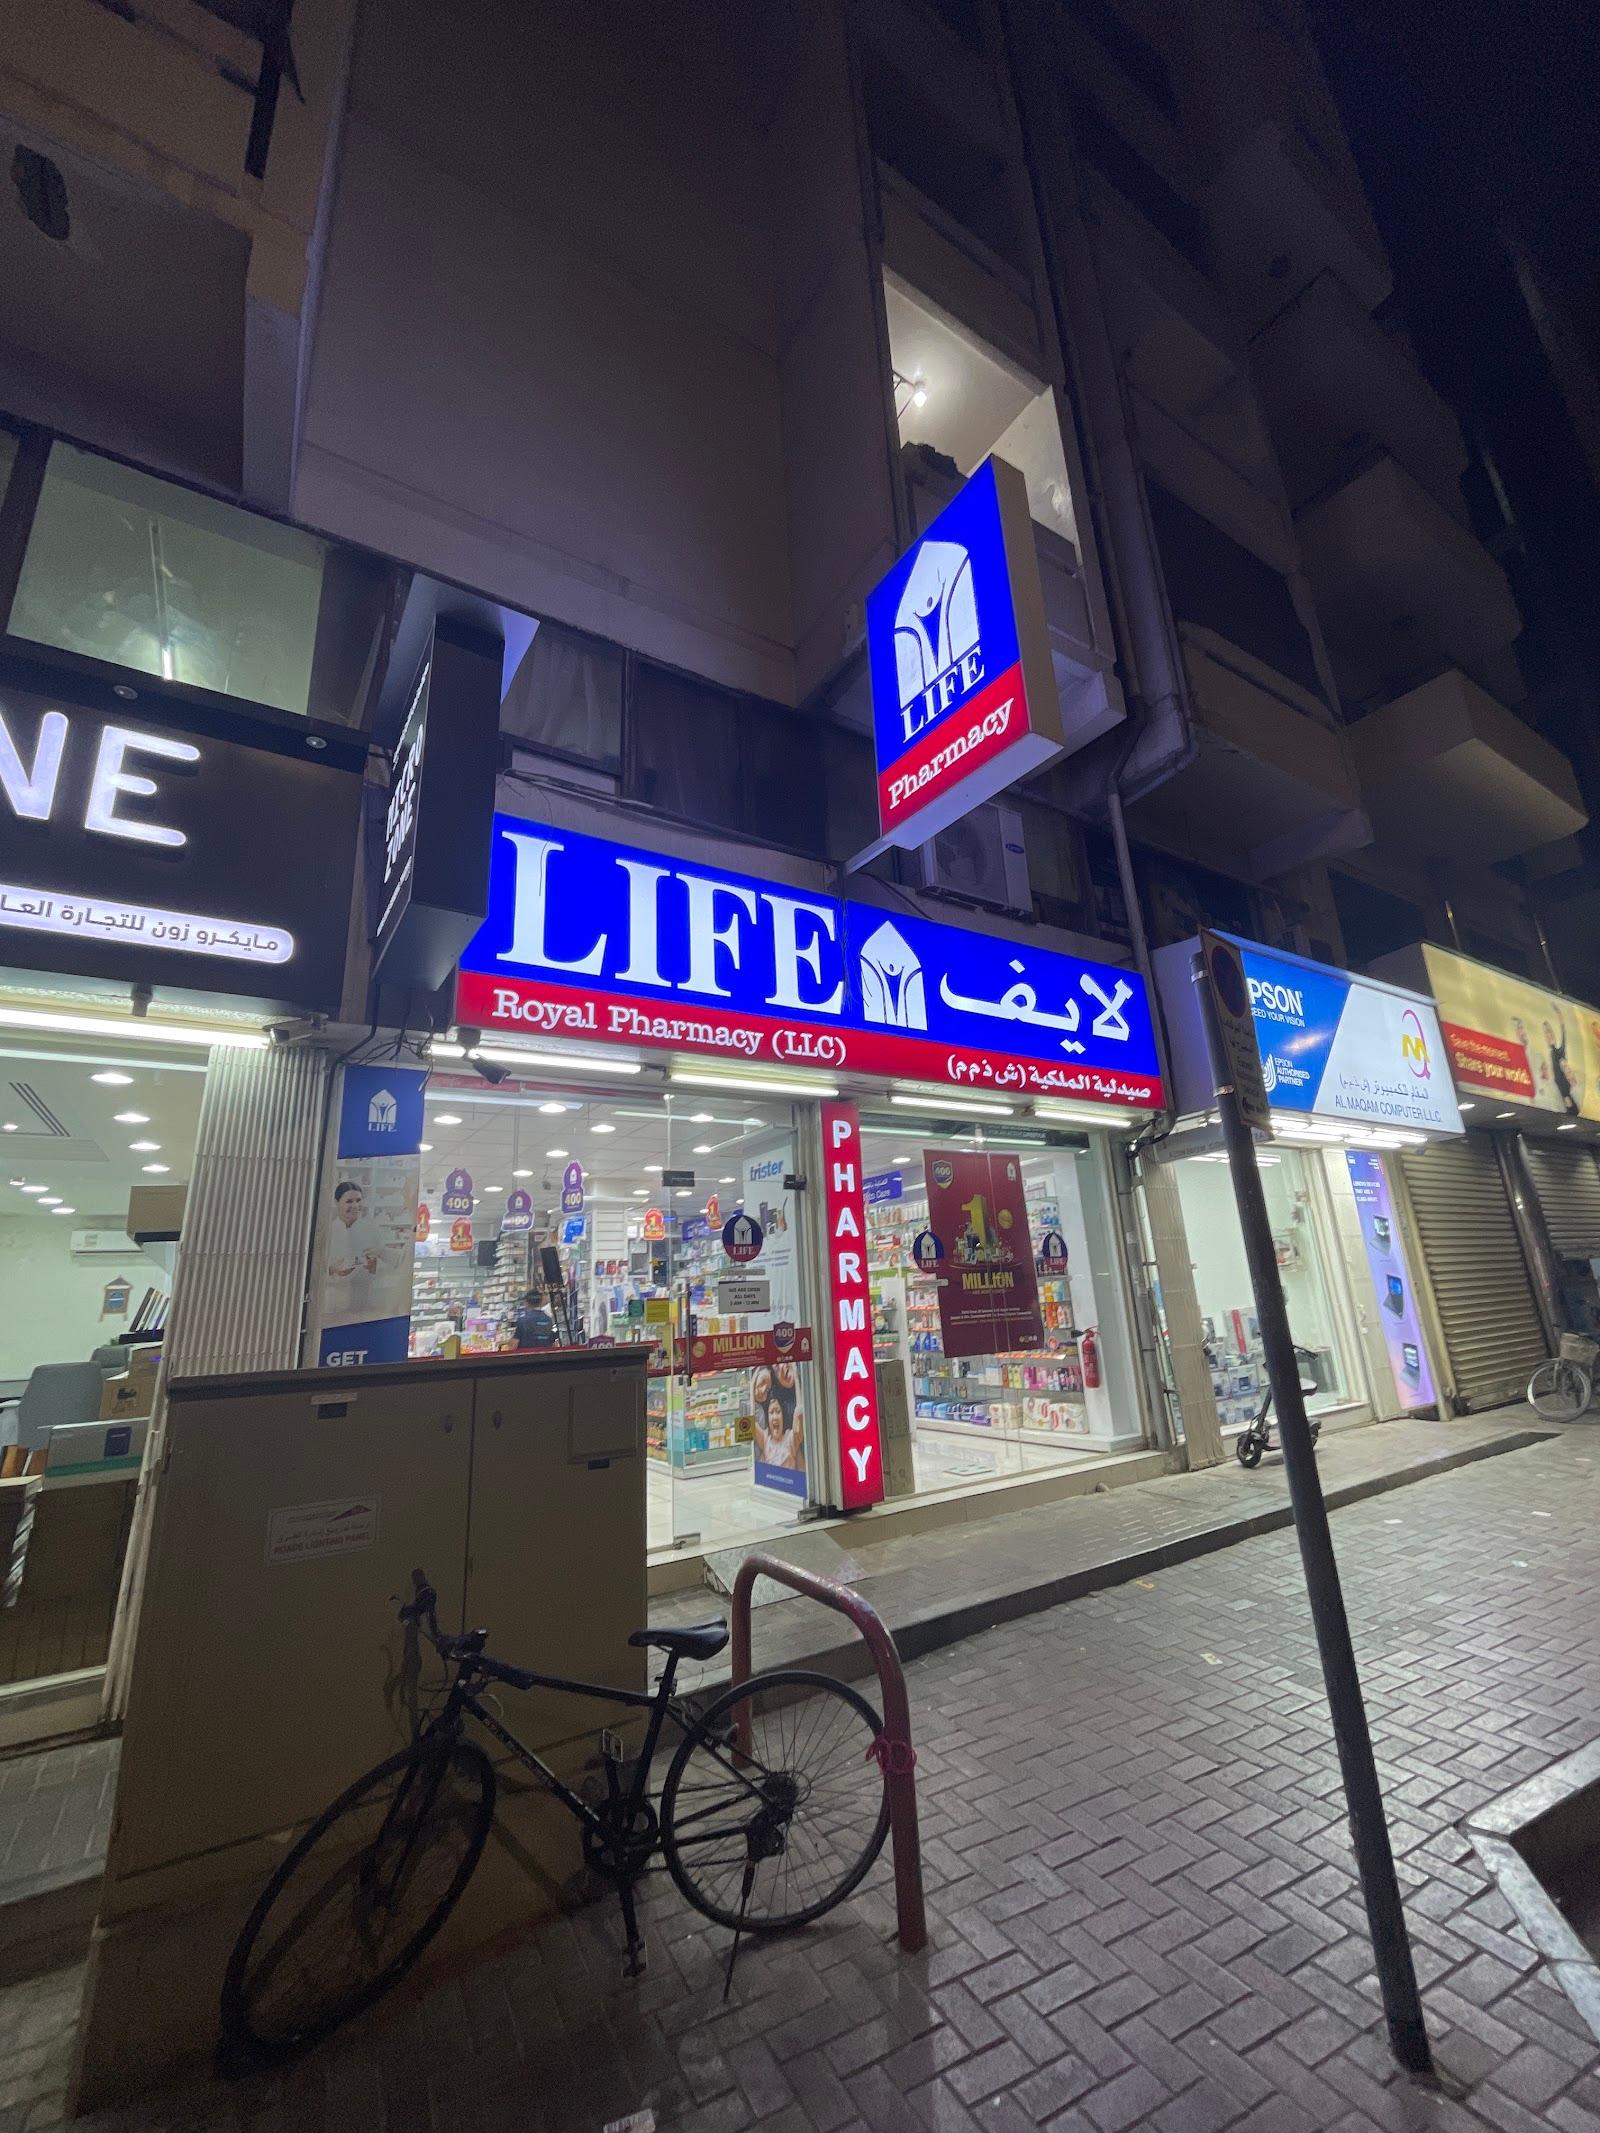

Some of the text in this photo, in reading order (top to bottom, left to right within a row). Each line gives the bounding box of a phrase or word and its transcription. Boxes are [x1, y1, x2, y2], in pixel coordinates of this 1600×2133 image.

[901, 646, 985, 743] LIFE
[888, 698, 1015, 810] Pharmacy
[61, 903, 146, 932] للتجارة
[496, 831, 845, 1015] LIFE
[152, 923, 191, 942] زون
[197, 930, 280, 952] مايكرو
[939, 958, 1134, 1056] لايف
[1246, 977, 1304, 1017] PSON
[493, 988, 847, 1066] Royal Pharmacy (LLC)
[1266, 1009, 1287, 1024] YOUR
[1285, 1014, 1306, 1028] VISION
[1274, 1057, 1294, 1069] EPSON
[1030, 1065, 1092, 1092] الملكية
[1276, 1066, 1310, 1081] AUTHORISED
[1278, 1075, 1304, 1088] PARTNER
[1092, 1073, 1151, 1100] صيدلية
[1335, 1094, 1347, 1109] AL
[1346, 1096, 1379, 1113] MAQAM
[1379, 1101, 1424, 1121] COMPUTER
[368, 1122, 398, 1132] LIFE
[750, 1160, 784, 1181] trister
[447, 1198, 469, 1209] 400
[564, 1192, 582, 1206] 400
[732, 1245, 753, 1256] LIFE
[961, 1271, 1015, 1290] MILLION
[831, 1120, 873, 1482] PHARMACY
[776, 1328, 793, 1338] 400
[713, 1334, 765, 1353] MILLION
[326, 1350, 369, 1367] GET
